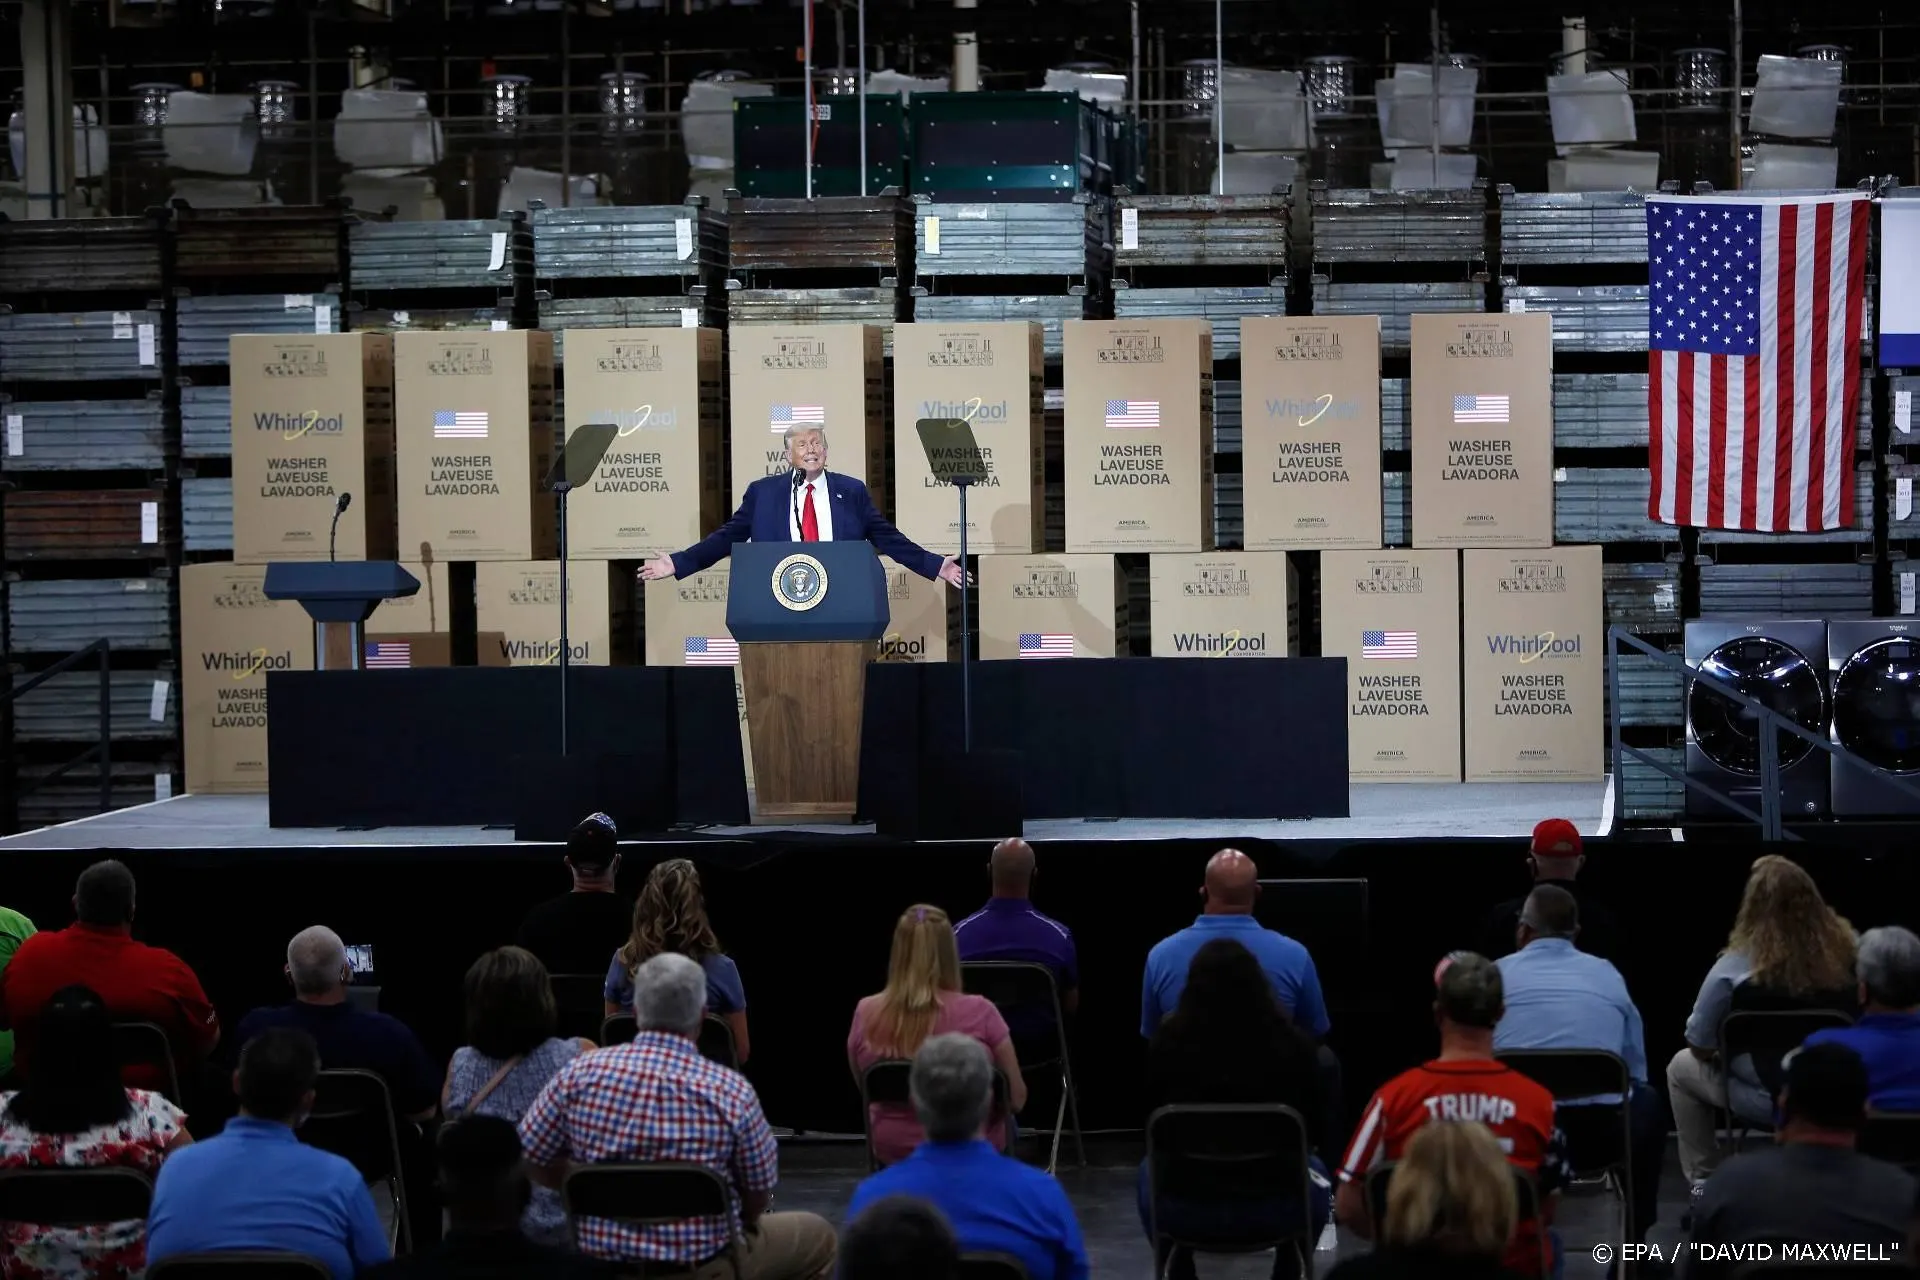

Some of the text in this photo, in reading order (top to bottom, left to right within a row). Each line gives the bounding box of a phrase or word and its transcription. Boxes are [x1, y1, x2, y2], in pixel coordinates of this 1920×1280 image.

[254, 412, 343, 436] Whirlpool
[1101, 446, 1162, 456] WASHER
[1279, 443, 1341, 454] WASHER
[1449, 440, 1511, 452] WASHER
[601, 453, 661, 464] WASHER
[932, 448, 992, 459] WASHER
[267, 458, 327, 469] WASHER
[431, 456, 492, 467] WASHER
[1100, 460, 1164, 470] LAVEUSE
[1278, 457, 1343, 468] LAVEUSE
[1448, 455, 1512, 466] LAVEUSE
[600, 467, 663, 478] LAVEUSE
[932, 462, 994, 472] LAVEUSE
[266, 472, 328, 483] LAVEUSE
[431, 470, 493, 481] LAVEUSE
[1094, 474, 1170, 485] LAVADORA
[1272, 471, 1350, 482] LAVADORA
[1442, 469, 1520, 480] LAVADORA
[594, 481, 670, 492] LAVADORA
[924, 476, 1000, 488] LAVORA
[261, 486, 335, 497] LAVADORA
[425, 484, 500, 496] LAVADORA
[880, 636, 924, 660] lpool
[1173, 632, 1265, 656] Whirlpool
[1487, 634, 1581, 658] Whirlpool
[202, 650, 290, 674] Whirlpool
[1359, 676, 1421, 687] WASHER
[1502, 675, 1564, 687] WASHER
[218, 688, 267, 700] WASHE
[1358, 690, 1422, 701] LAVEUSE
[1501, 690, 1566, 701] LAVEUSE
[218, 703, 268, 714] LAVEUS
[1352, 704, 1429, 716] LAVADORA
[1495, 704, 1572, 715] LAVADORA
[212, 716, 266, 728] LAVADO
[1424, 1092, 1516, 1124] TRUMP
